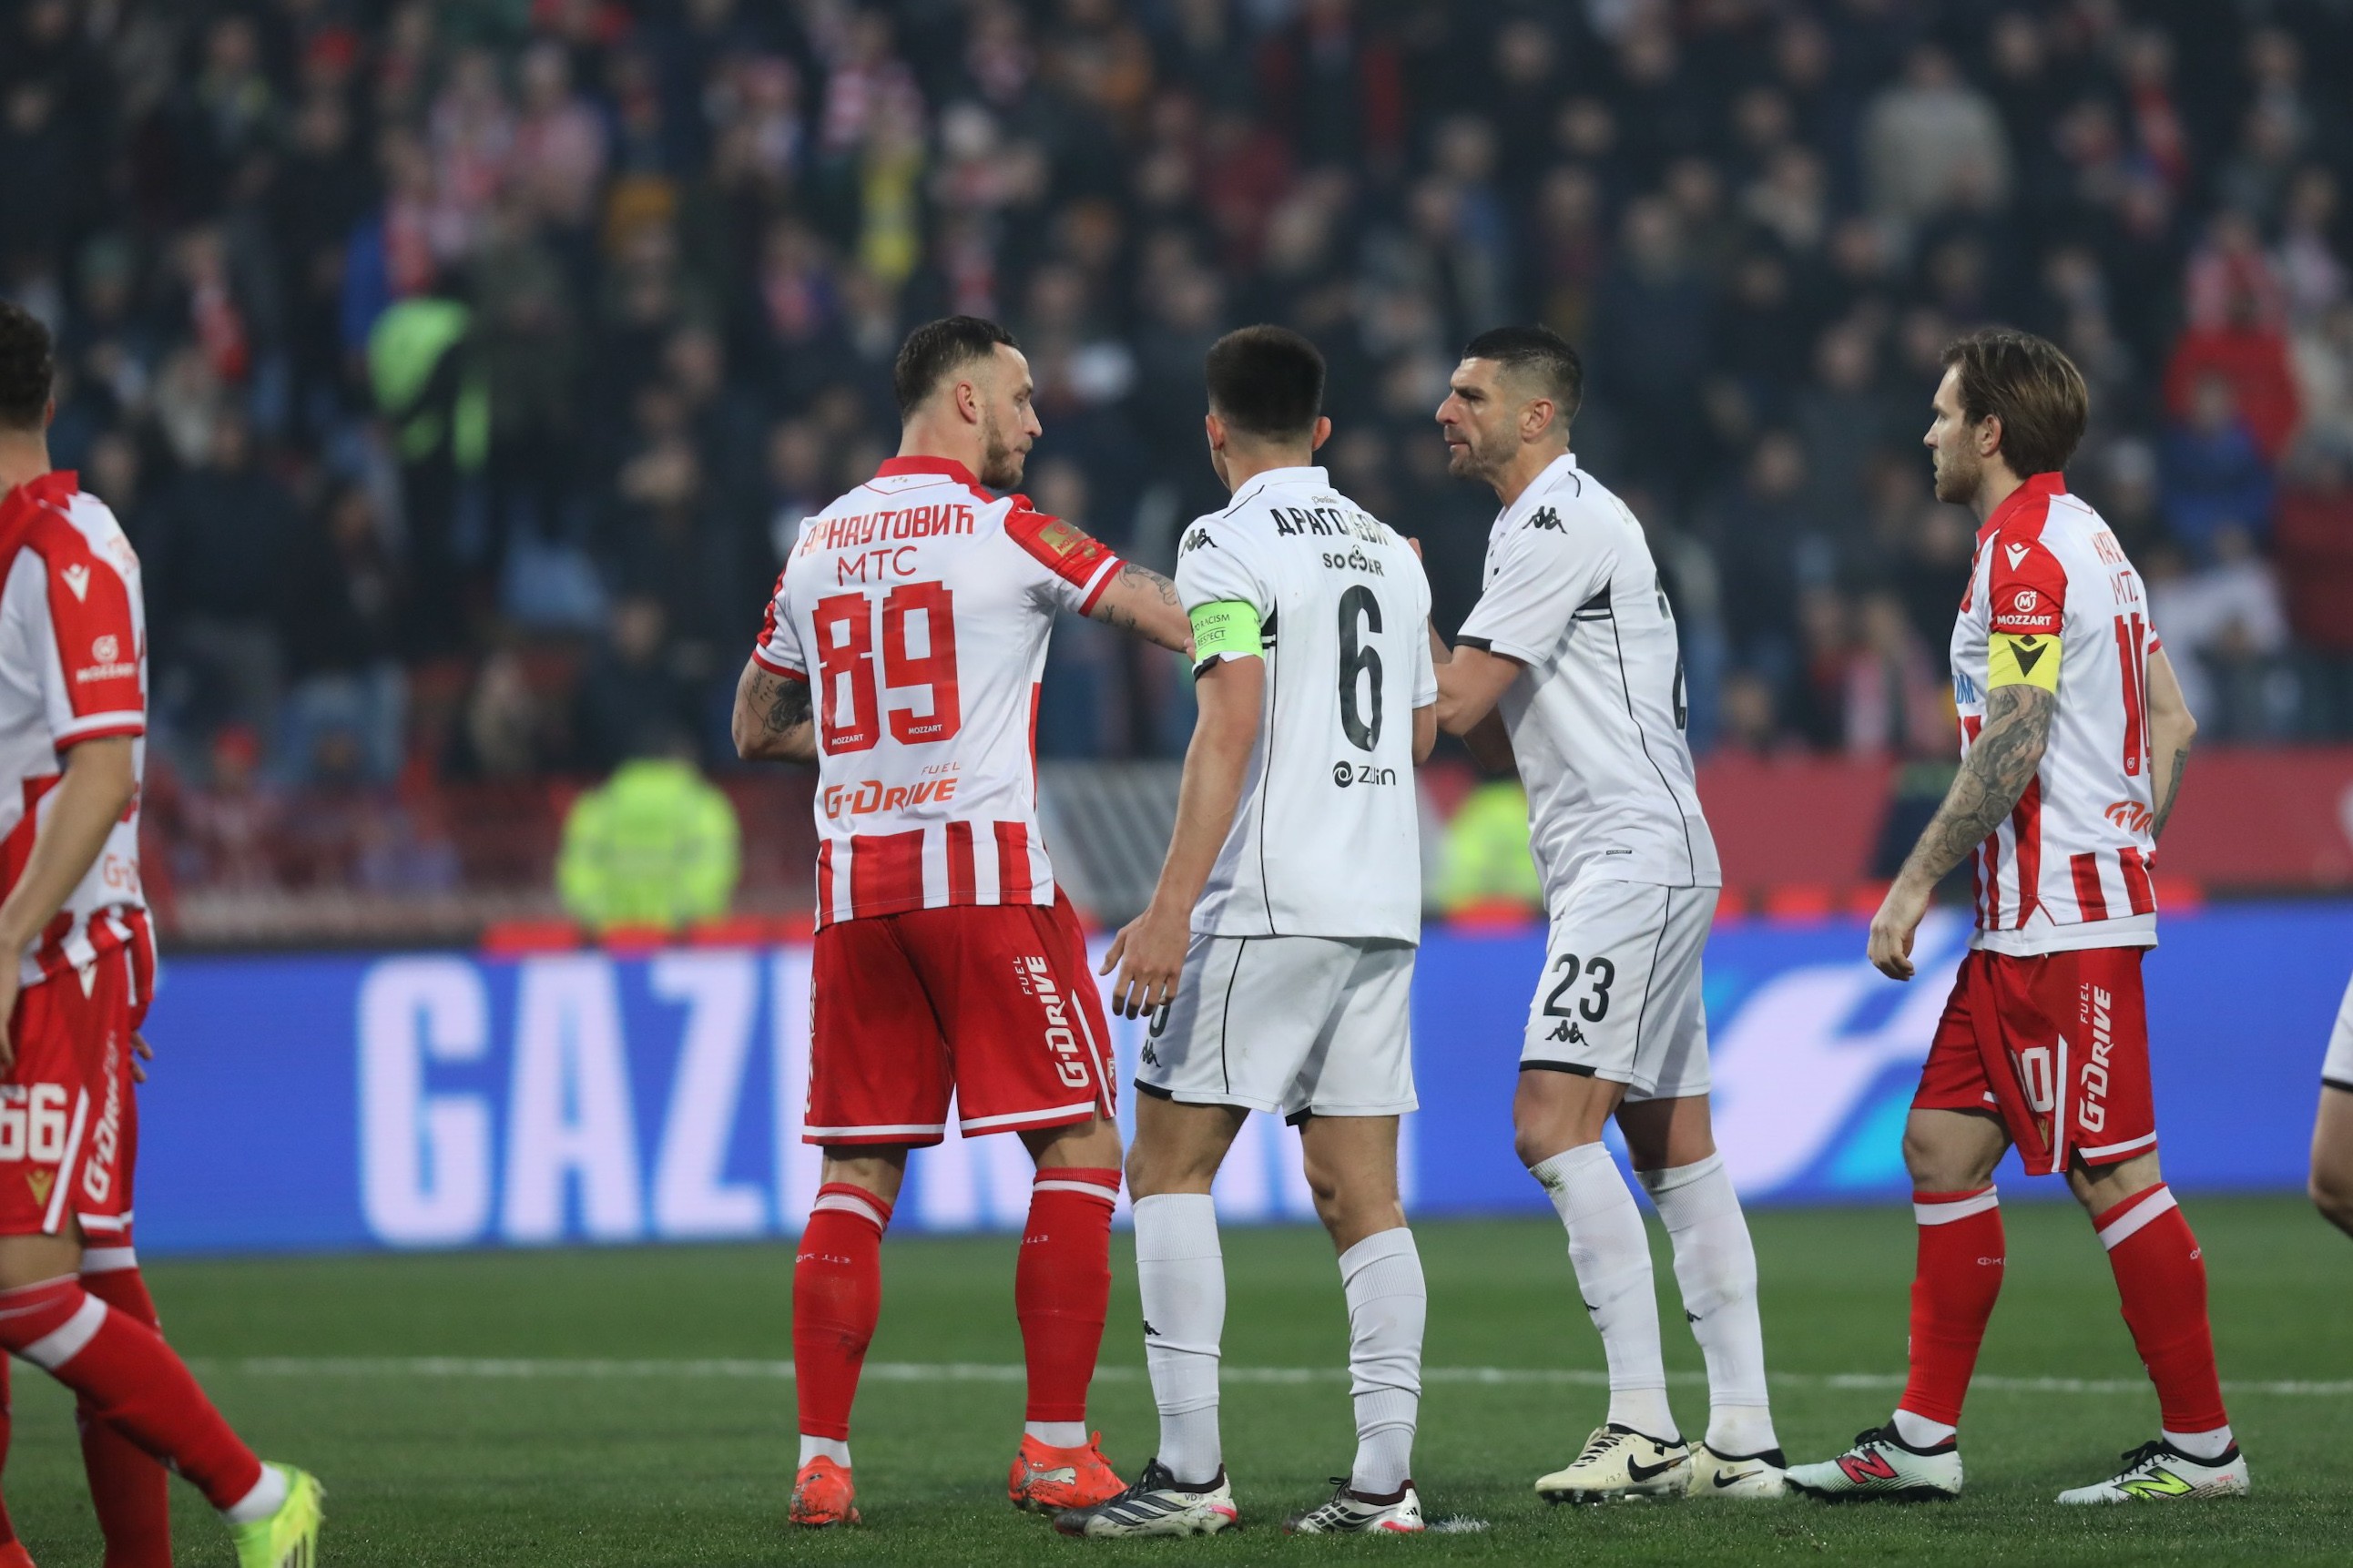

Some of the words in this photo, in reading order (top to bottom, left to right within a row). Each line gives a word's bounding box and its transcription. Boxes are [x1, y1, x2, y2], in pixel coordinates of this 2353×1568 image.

[800, 504, 974, 557] АРНАУТОВИЋ
[1322, 550, 1385, 576] SOCCER
[2109, 570, 2138, 606] МТ
[1200, 614, 1230, 627] RACISM
[1997, 615, 2052, 626] MOZZART
[811, 580, 962, 757] 89
[1338, 584, 1383, 752] 6
[831, 733, 864, 746] MOZZART
[908, 724, 942, 735] MOZZART
[921, 761, 961, 776] FUEL
[1013, 956, 1033, 995] FUEL
[1543, 953, 1615, 1023] 23
[2079, 982, 2089, 1024] FUEL
[0, 1083, 67, 1163] 66
